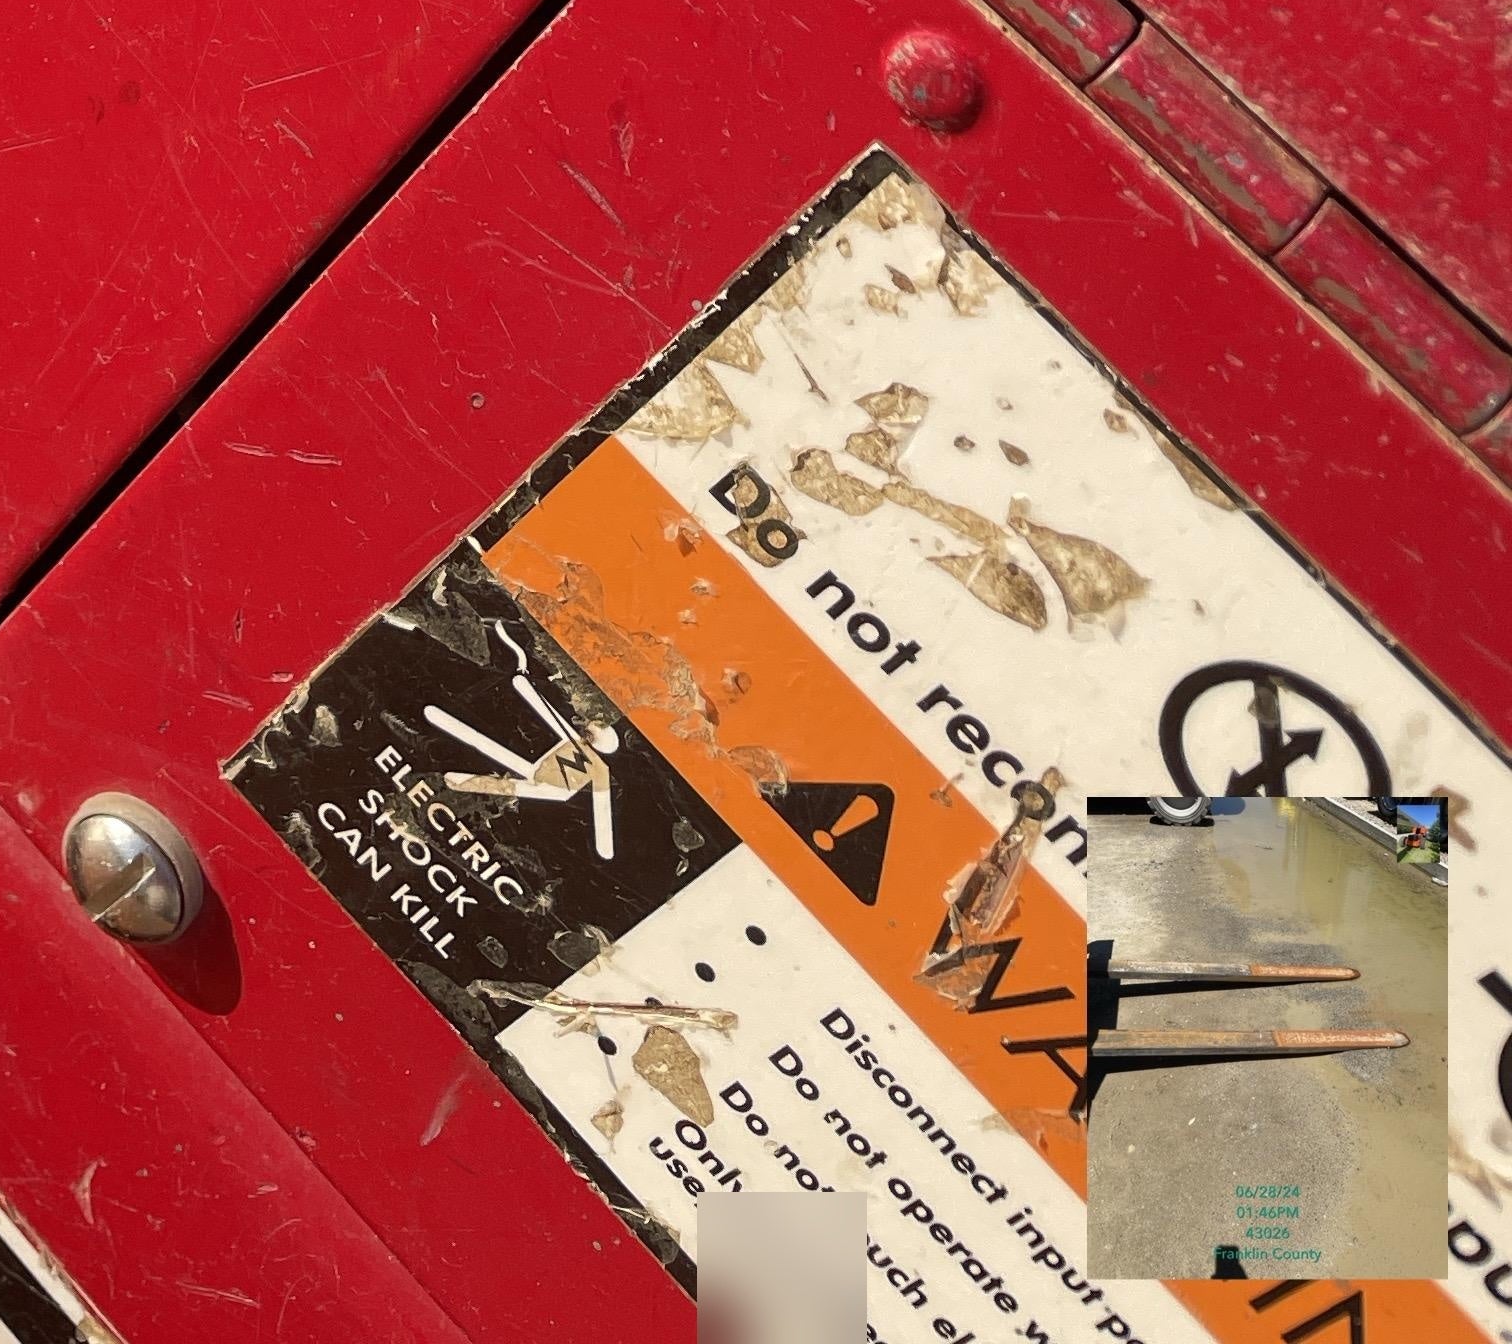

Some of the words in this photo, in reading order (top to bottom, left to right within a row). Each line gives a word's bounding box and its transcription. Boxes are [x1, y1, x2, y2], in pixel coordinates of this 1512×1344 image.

[708, 463, 800, 567] Do
[805, 569, 923, 678] not
[915, 683, 1087, 878] recon
[317, 802, 393, 883] CAN
[390, 884, 459, 960] KILL
[358, 789, 478, 918] SHOCK
[374, 745, 524, 906] ELECTRIC
[719, 1080, 770, 1137] Do
[867, 1234, 929, 1309] uch
[768, 1044, 821, 1101] Do
[823, 1109, 888, 1169] not
[888, 1178, 1019, 1314] operate
[819, 1007, 1009, 1204] Disconnect
[1006, 1207, 1104, 1306] input
